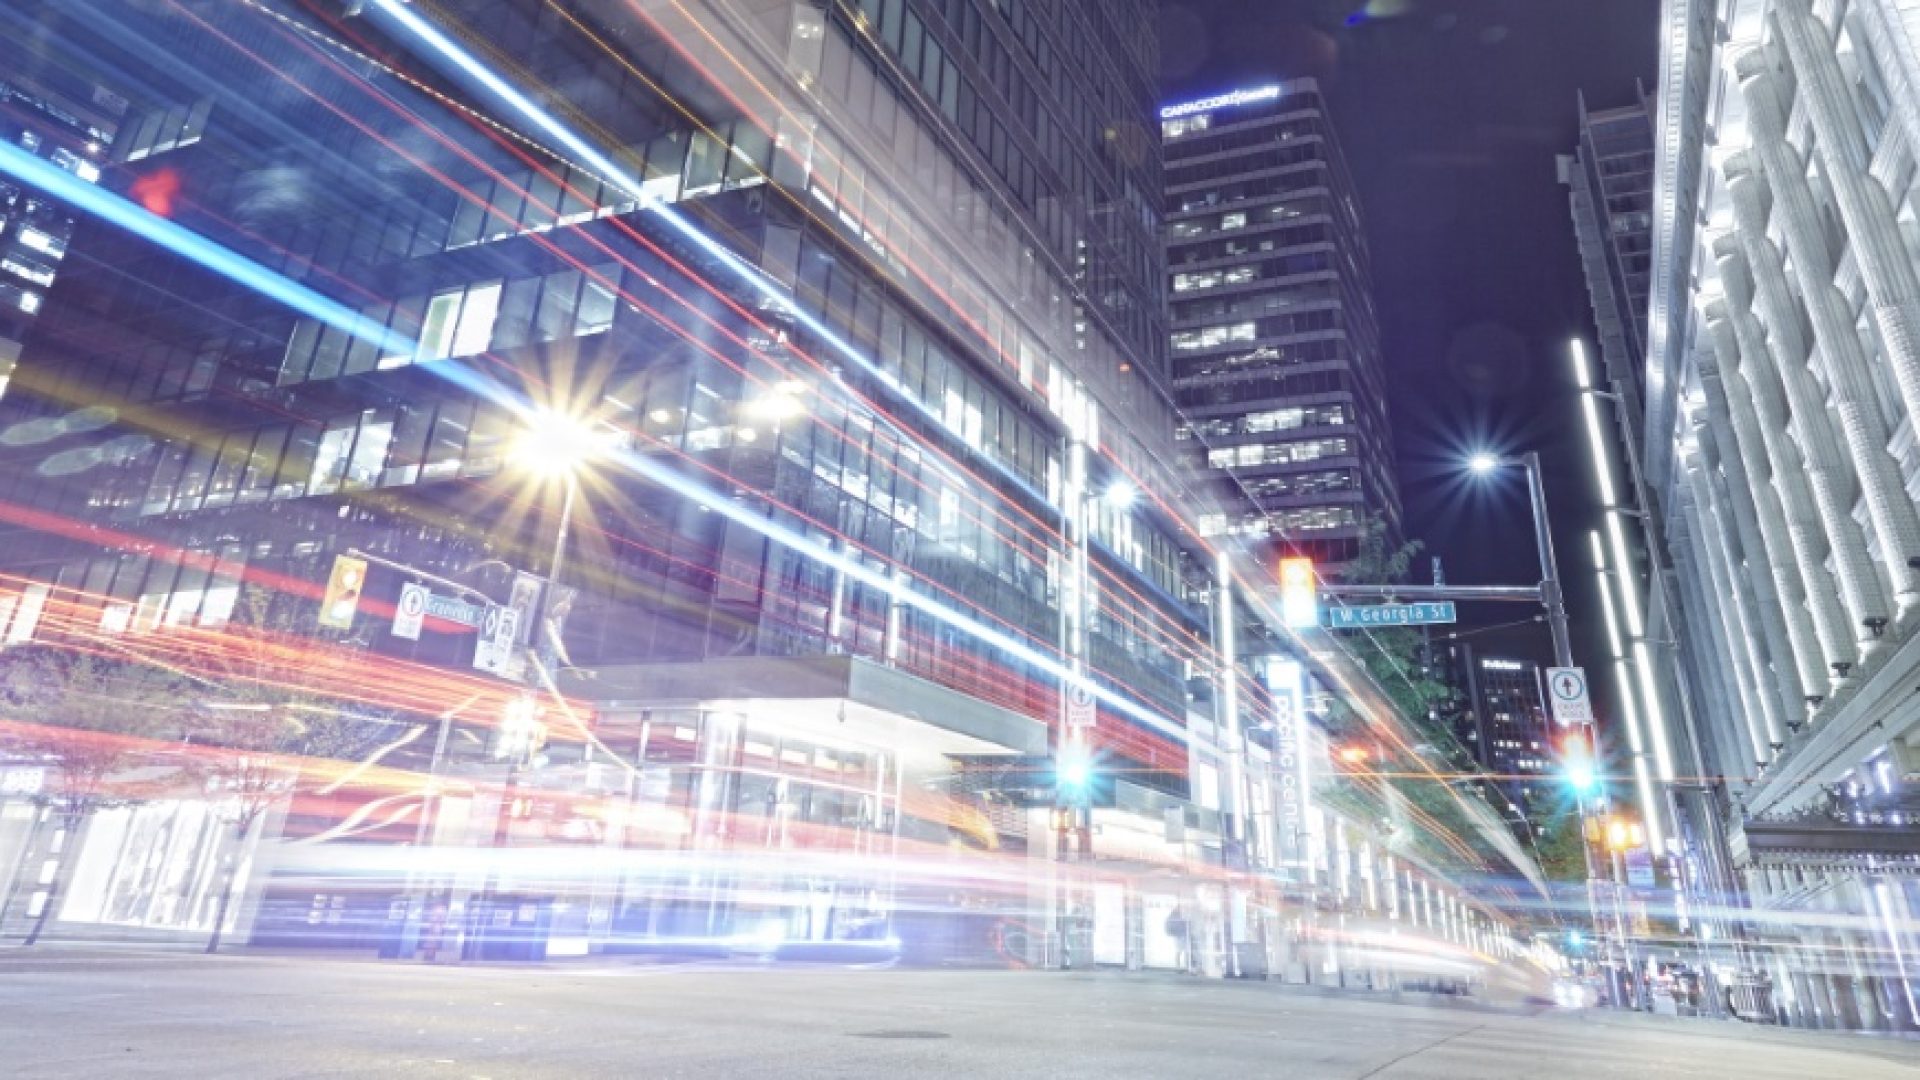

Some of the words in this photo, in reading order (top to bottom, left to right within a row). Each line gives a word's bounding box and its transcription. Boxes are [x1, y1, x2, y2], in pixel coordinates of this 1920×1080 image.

[1340, 608, 1353, 622] W
[1360, 605, 1424, 625] Georgia
[1431, 603, 1446, 618] St
